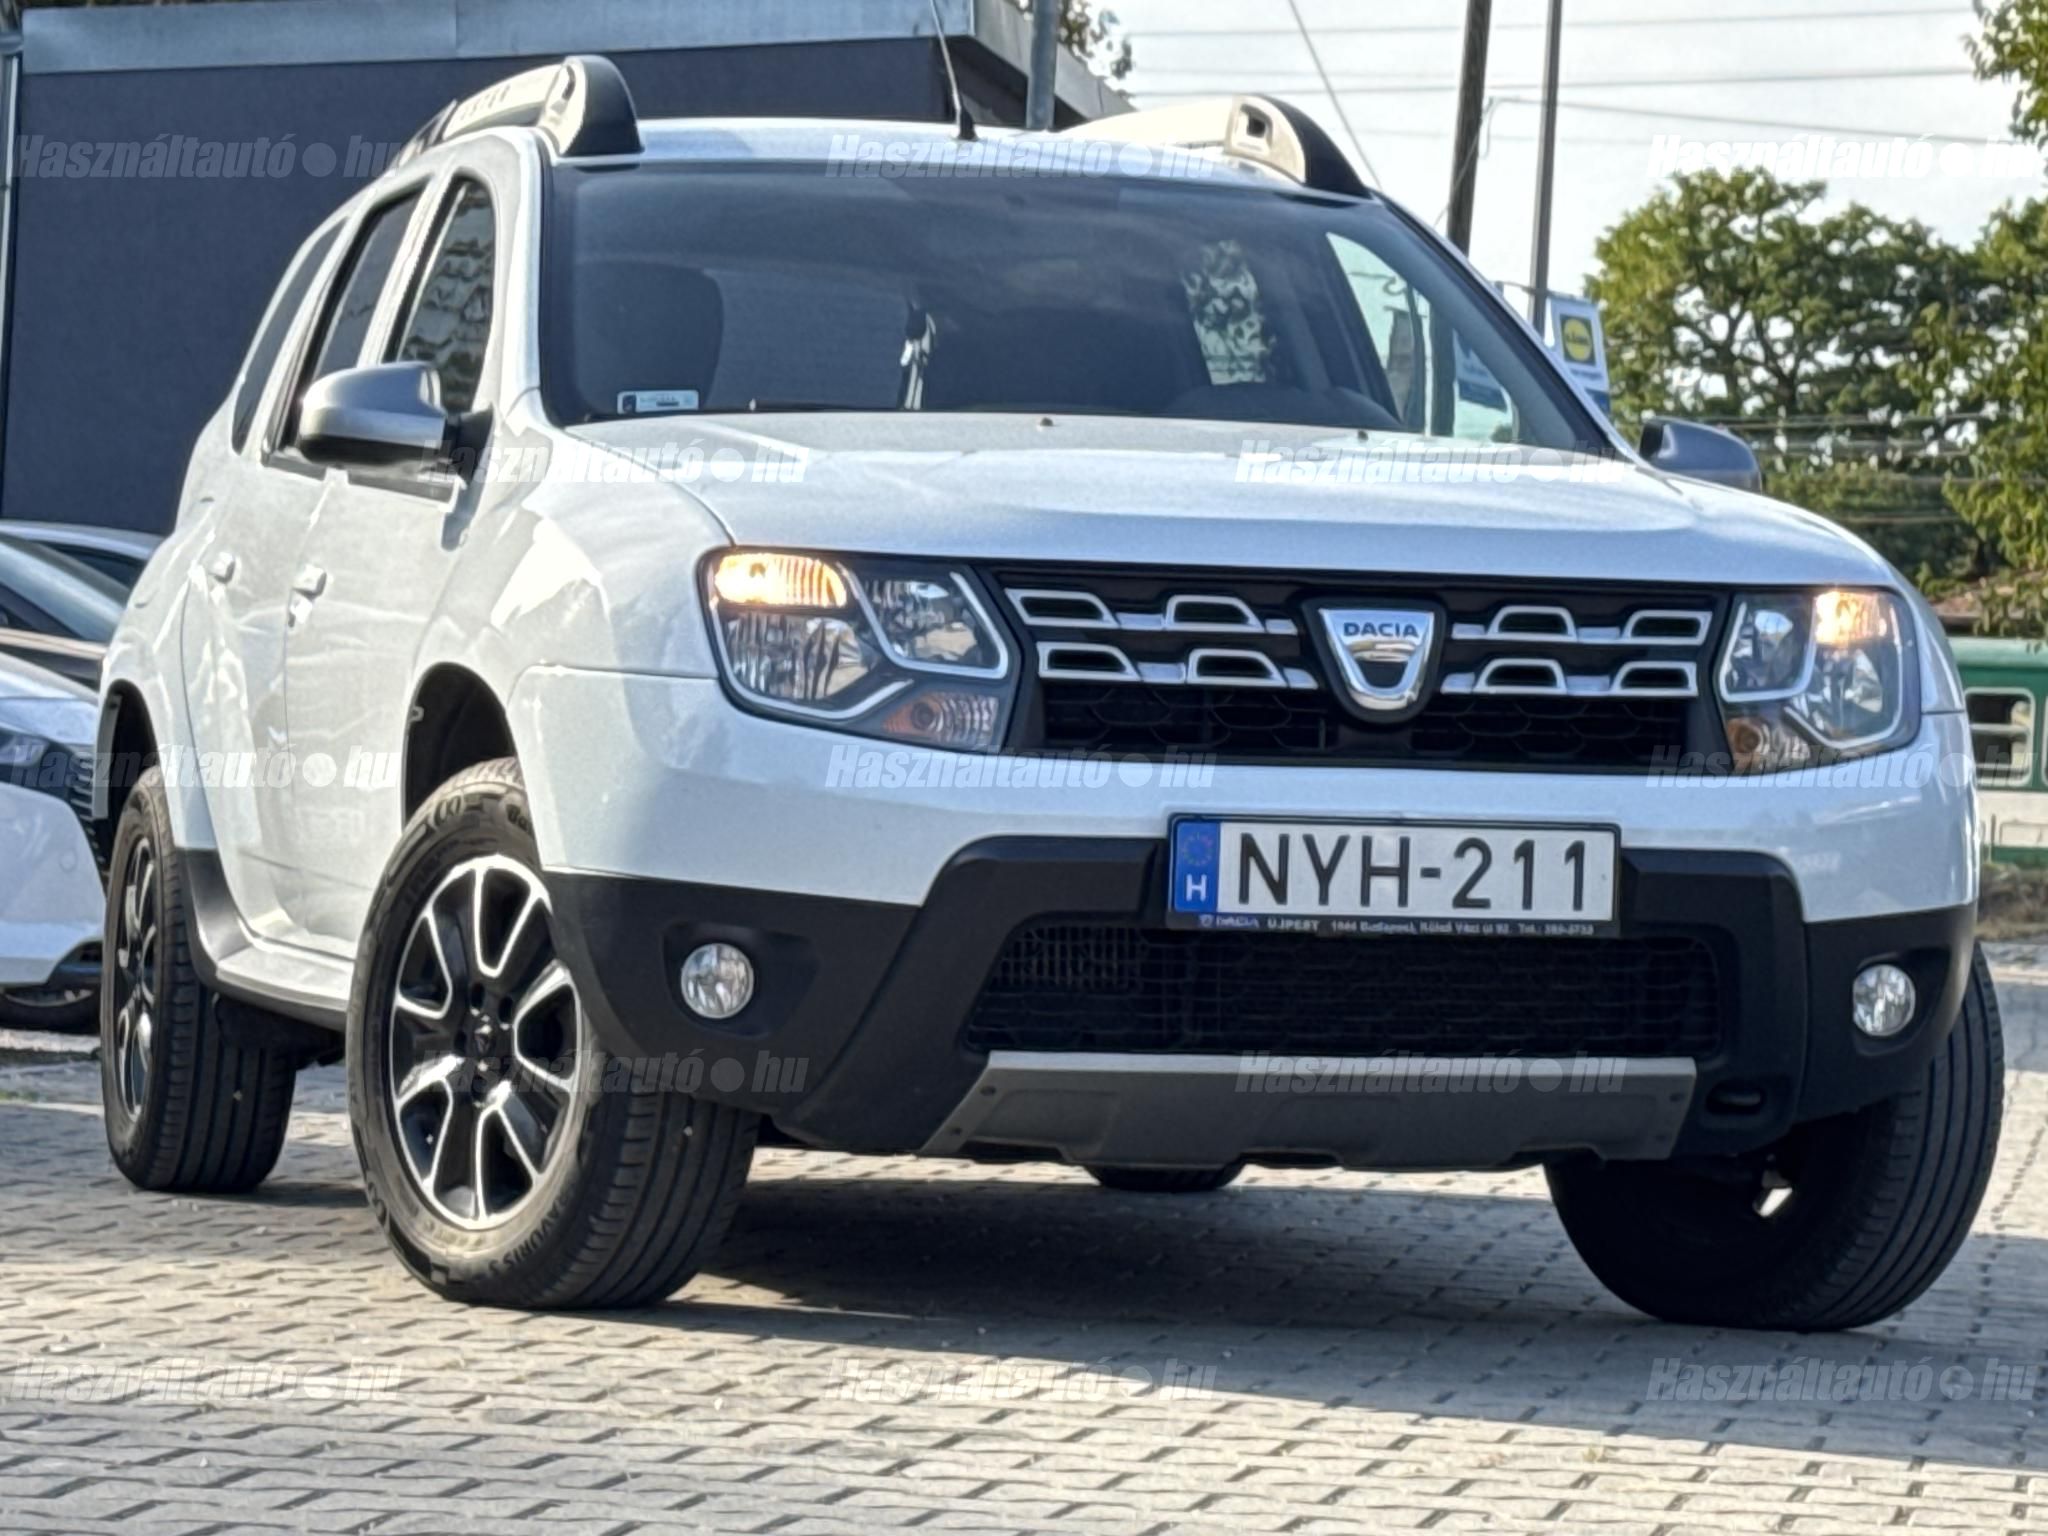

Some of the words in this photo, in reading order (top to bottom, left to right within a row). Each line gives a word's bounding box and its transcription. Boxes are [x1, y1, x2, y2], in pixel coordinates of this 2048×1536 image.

[1343, 622, 1419, 638] DACIA
[1239, 833, 1586, 911] NYH-211
[1185, 874, 1207, 903] H
